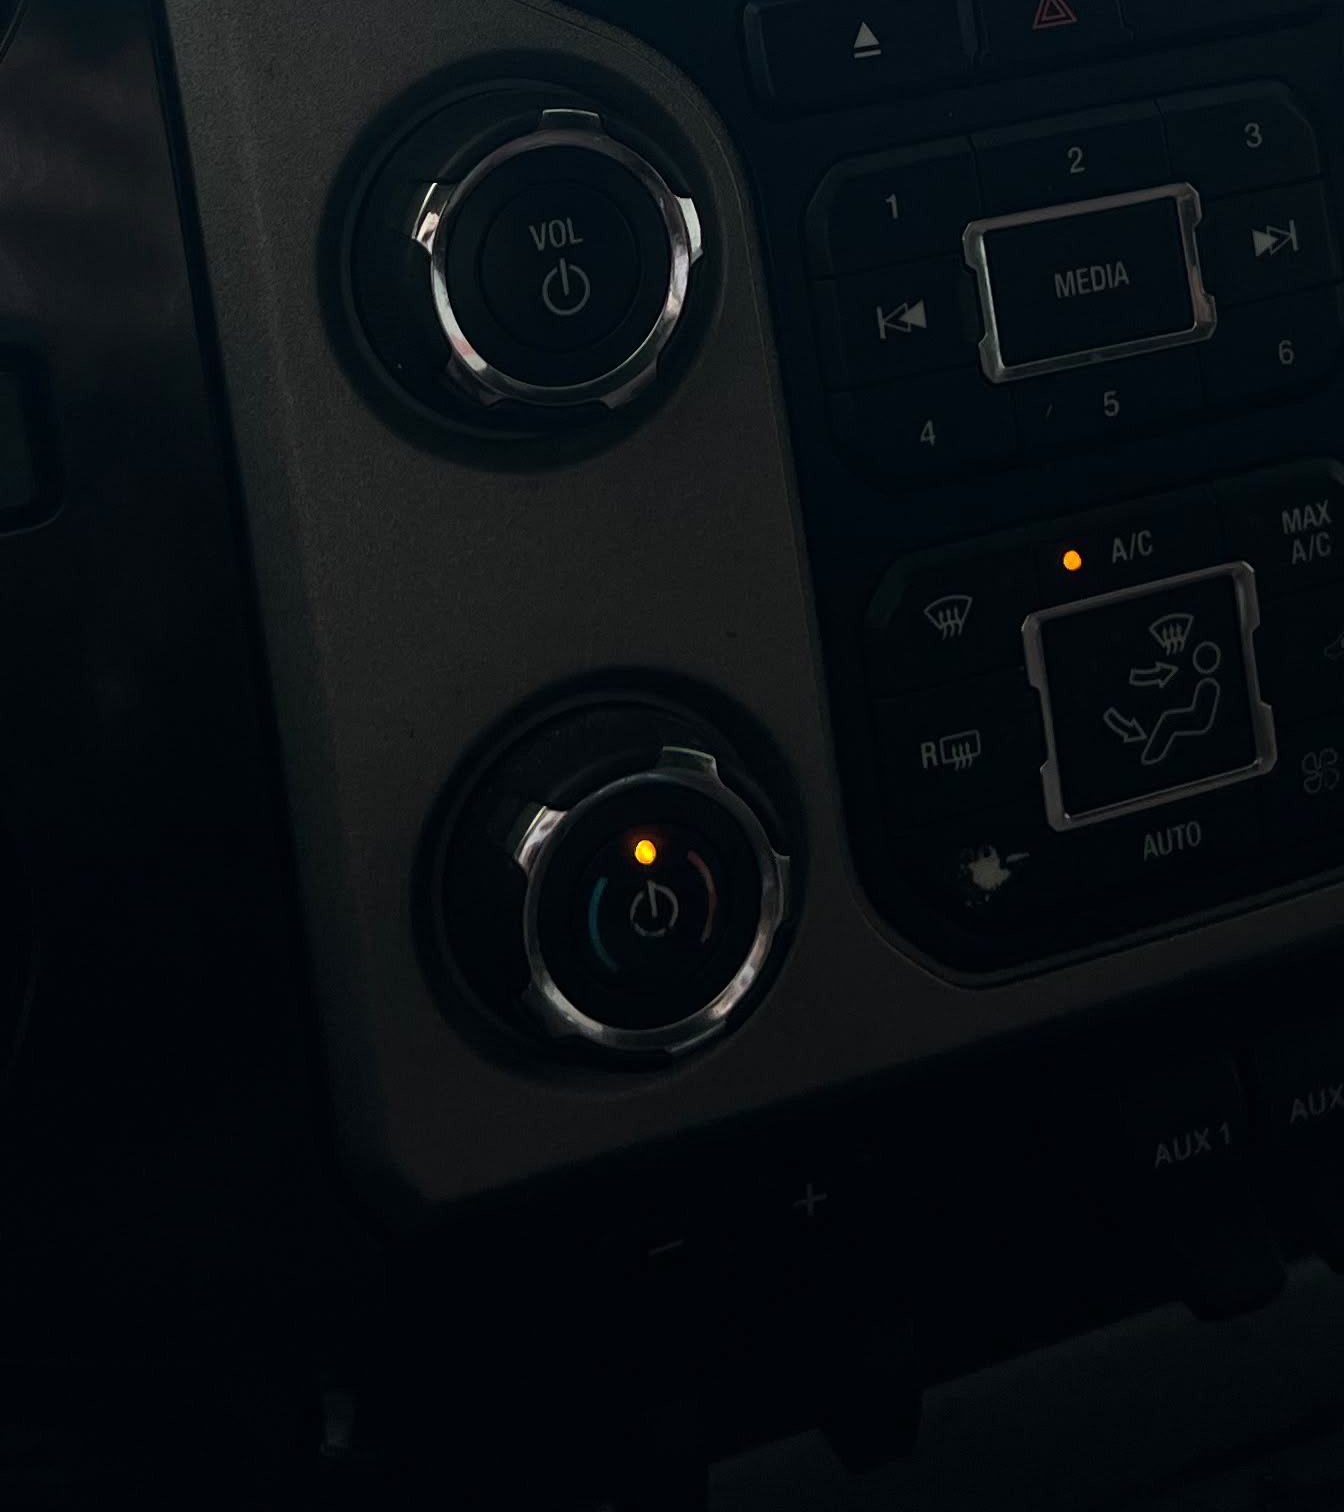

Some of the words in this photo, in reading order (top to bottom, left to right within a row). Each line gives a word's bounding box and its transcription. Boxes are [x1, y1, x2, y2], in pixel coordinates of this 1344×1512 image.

[1244, 122, 1263, 149] 3
[1066, 146, 1085, 175] 2
[884, 192, 900, 220] 1
[528, 216, 585, 252] VOL
[1053, 260, 1131, 300] MEDIA
[1277, 339, 1296, 366] 6
[1102, 390, 1121, 418] 5
[919, 419, 937, 447] 4
[1281, 498, 1333, 536] MAX
[1110, 529, 1154, 565] A/C
[1290, 531, 1334, 566] A/C
[1142, 820, 1203, 862] AUTO
[1154, 1126, 1212, 1170] AUX
[1218, 1120, 1233, 1147] 1
